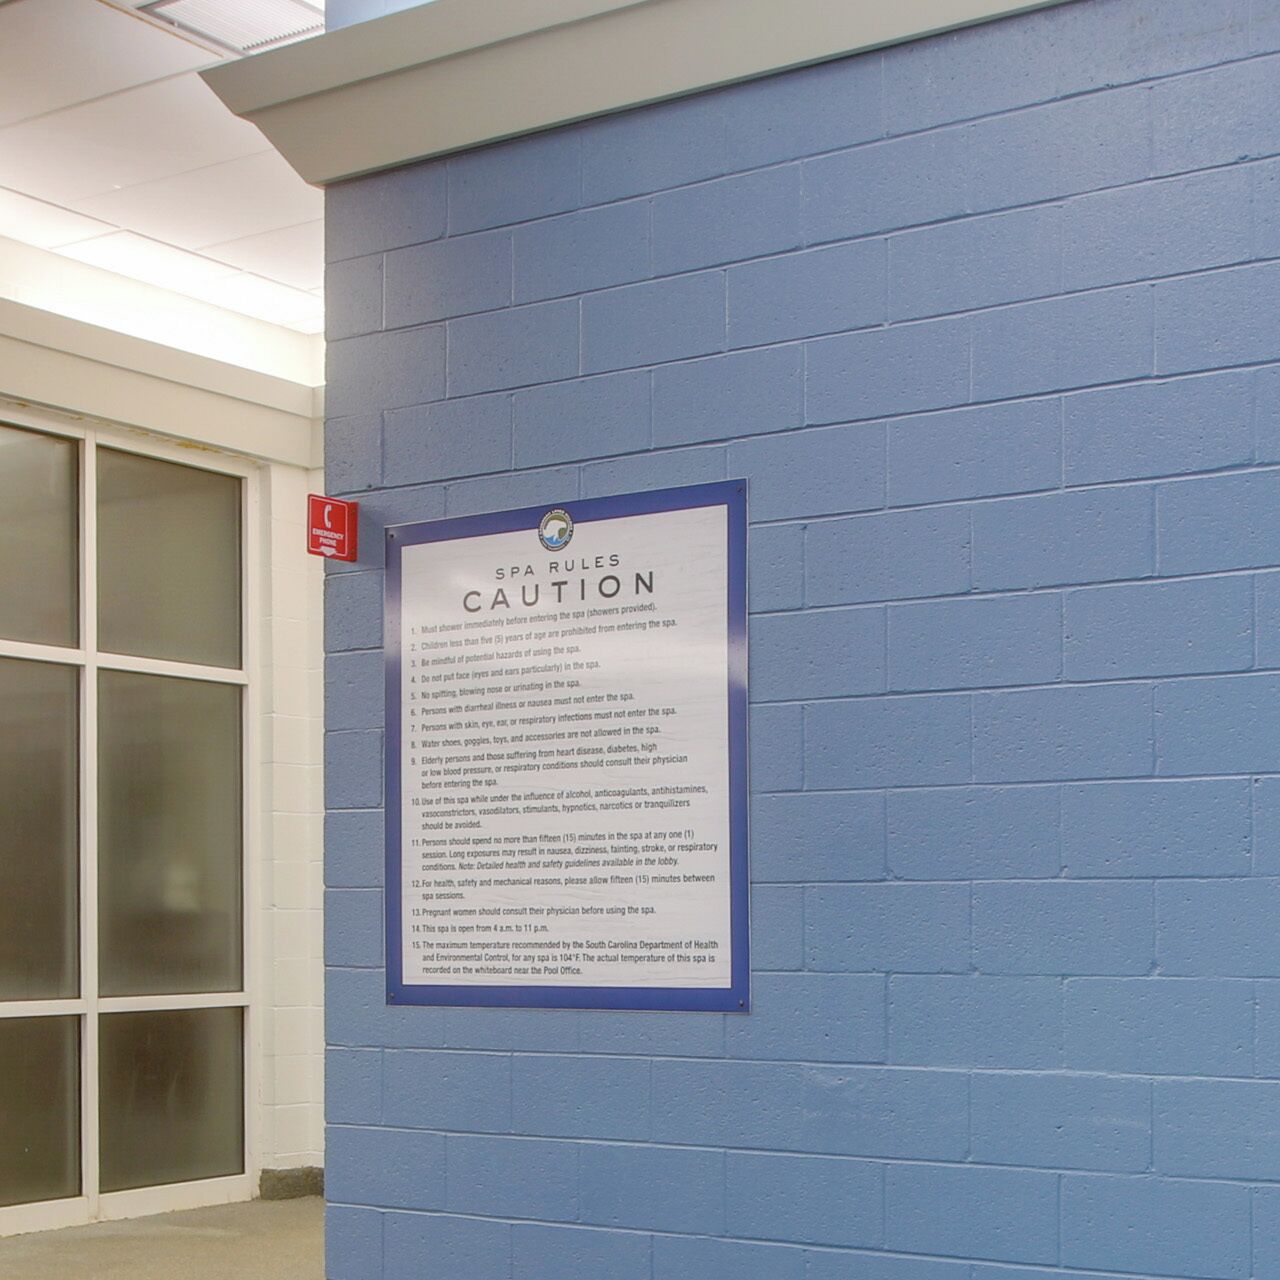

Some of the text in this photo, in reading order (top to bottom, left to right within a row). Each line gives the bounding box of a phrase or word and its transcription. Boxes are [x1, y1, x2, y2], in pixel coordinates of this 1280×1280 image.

[312, 528, 344, 540] EMERGENCY
[320, 536, 336, 546] PHONE
[496, 554, 620, 580] SPA RULES
[463, 571, 653, 613] CAUTION
[420, 755, 444, 766] Elderly
[444, 755, 471, 765] persons
[471, 753, 485, 762] and
[485, 752, 505, 761] those
[505, 750, 537, 761] suffering
[537, 748, 555, 758] from
[555, 747, 575, 756] heart
[640, 742, 657, 753] high
[420, 797, 434, 806] Use
[434, 797, 442, 805] of
[442, 796, 456, 805] this
[456, 797, 469, 806] spa
[469, 794, 489, 803] while
[489, 793, 509, 802] under
[510, 793, 522, 801] the
[522, 791, 555, 801] influence
[556, 791, 564, 799] of
[598, 800, 633, 810] narcotics
[633, 801, 642, 809] or
[643, 798, 690, 810] tranquilizers
[420, 879, 432, 887] For
[456, 878, 477, 888] safety
[478, 878, 492, 886] and
[492, 877, 532, 886] mechanical
[563, 875, 588, 886] please
[588, 875, 609, 884] allow
[609, 874, 634, 883] fifteen
[634, 874, 650, 884] (15)
[650, 873, 681, 882] minutes
[682, 872, 715, 882] between
[421, 893, 434, 901] spa
[421, 908, 451, 918] Pregnant
[477, 907, 501, 915] should
[501, 907, 528, 915] consult
[528, 906, 544, 915] their
[545, 906, 580, 916] physician
[580, 905, 604, 914] before
[605, 905, 626, 915] using
[626, 905, 639, 913] the
[422, 941, 434, 949] The
[434, 940, 468, 949] maximum
[468, 940, 510, 950] temperature
[510, 940, 561, 948] recommended
[561, 940, 571, 950] by
[571, 940, 584, 948] the
[584, 940, 606, 948] South
[606, 940, 638, 948] Carolina
[638, 939, 683, 950] Department
[683, 939, 693, 948] of
[693, 939, 719, 948] Health
[421, 953, 435, 961] and
[435, 953, 483, 961] Environmental
[510, 953, 521, 961] for
[522, 954, 535, 962] any
[536, 954, 550, 962] spa
[550, 953, 558, 961] is
[581, 953, 595, 961] The
[596, 953, 619, 961] actual
[620, 952, 666, 963] temperature
[666, 952, 675, 961] of
[675, 952, 691, 961] this
[692, 954, 707, 963] spa
[707, 952, 715, 961] is
[421, 965, 451, 973] recorded
[461, 965, 473, 973] the
[474, 965, 513, 974] whiteboard
[529, 966, 542, 974] the
[542, 966, 559, 974] Pool
